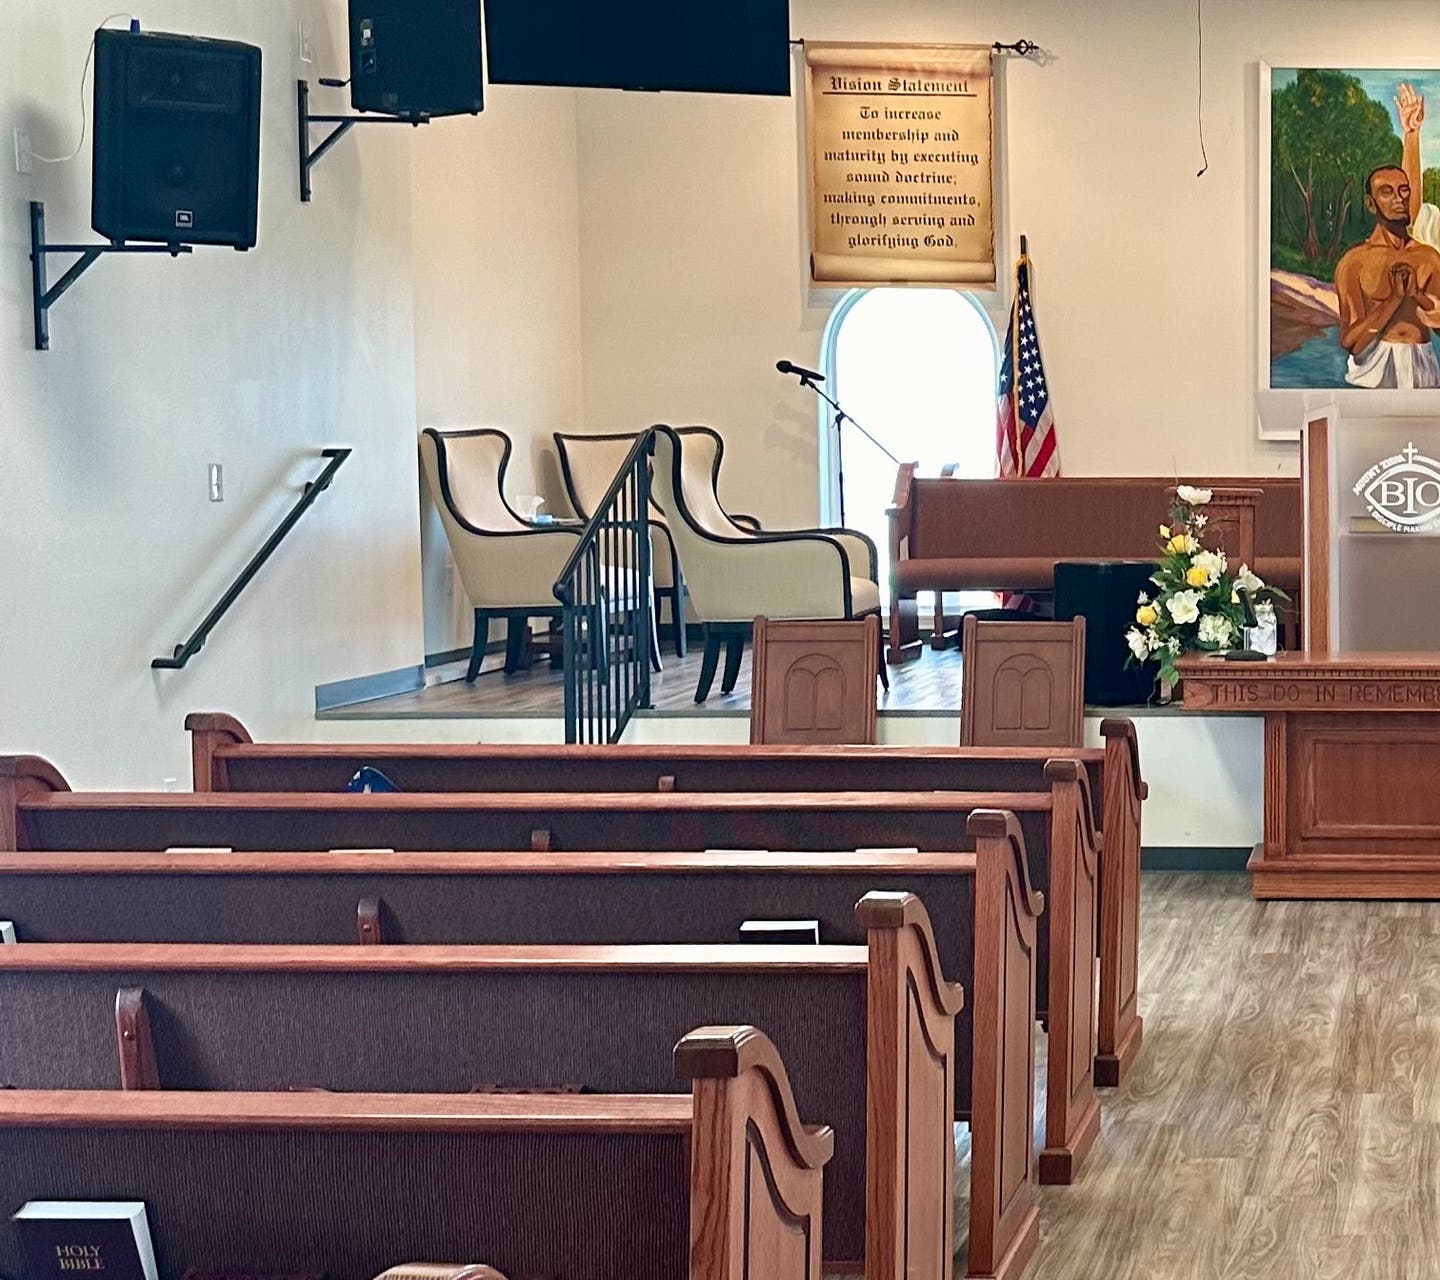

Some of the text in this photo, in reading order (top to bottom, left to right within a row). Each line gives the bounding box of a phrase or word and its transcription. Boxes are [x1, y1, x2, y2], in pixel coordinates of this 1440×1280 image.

[830, 76, 969, 92] Vision Statement
[860, 106, 942, 120] To increase
[842, 128, 960, 144] membership and
[824, 149, 979, 166] maturity by executing
[846, 171, 890, 184] sound
[823, 192, 876, 207] making
[830, 212, 976, 229] through serving and
[848, 233, 919, 249] glorifying
[1352, 464, 1381, 496] MOUNT
[1211, 683, 1259, 703] THIS
[1273, 683, 1300, 703] DO
[1314, 684, 1336, 703] IN
[56, 1245, 101, 1257] HOLY
[59, 1258, 105, 1270] BIBLE
